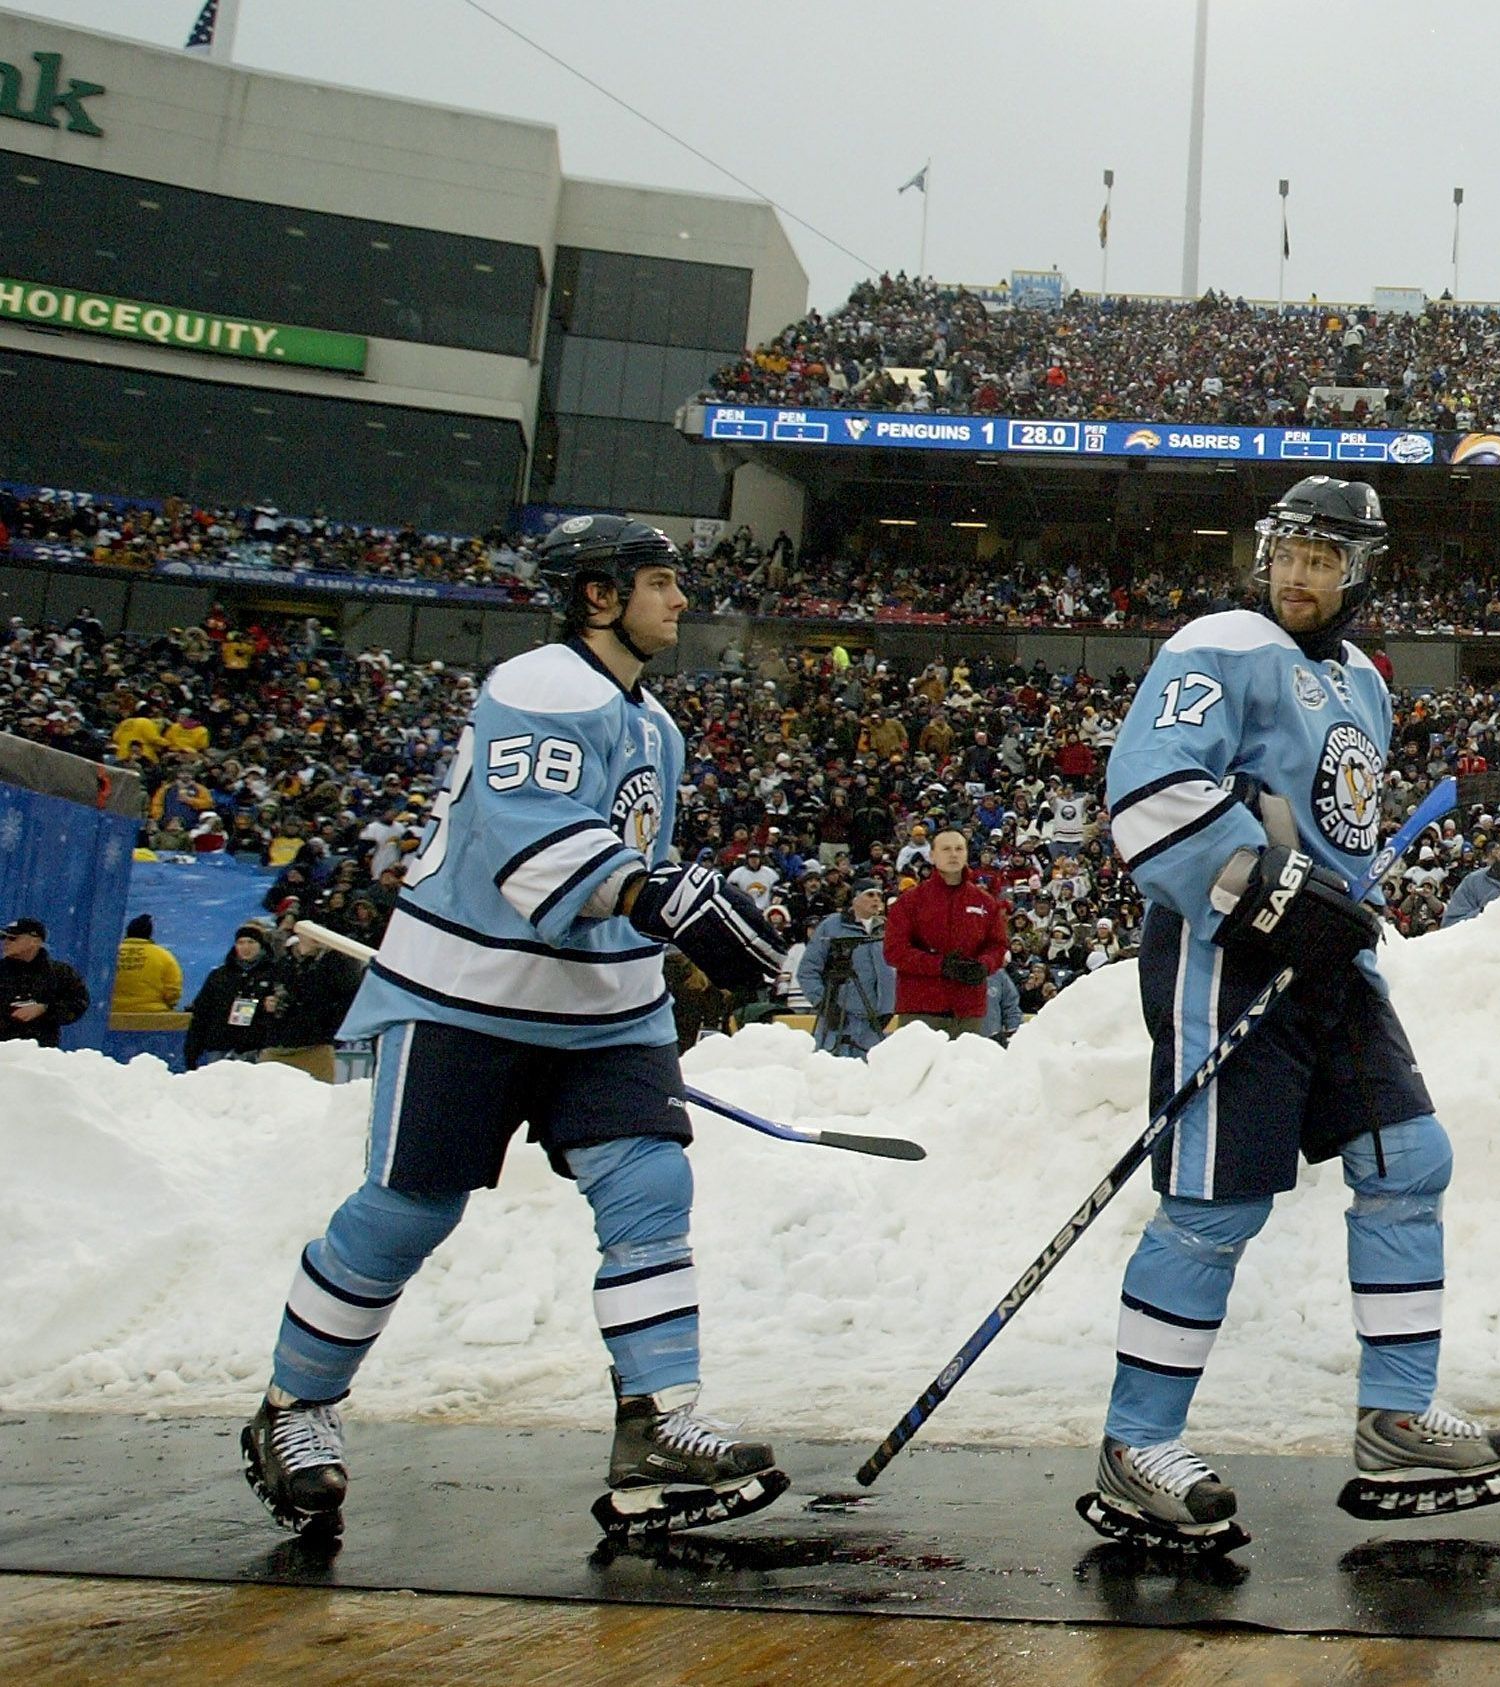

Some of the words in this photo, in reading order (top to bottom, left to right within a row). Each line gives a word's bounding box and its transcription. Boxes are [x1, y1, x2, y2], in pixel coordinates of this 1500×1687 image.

[717, 409, 745, 421] PEN
[779, 412, 806, 424] PEN
[876, 422, 970, 441] PENGUINS
[981, 423, 994, 444] 1
[1021, 427, 1066, 445] 28.0
[1084, 425, 1107, 435] PER
[1090, 437, 1099, 449] 2
[1168, 433, 1241, 451] SABRES
[1253, 433, 1266, 455] 1
[1154, 671, 1223, 729] 17
[486, 732, 584, 795] 58
[998, 1177, 1114, 1320] EASTON
